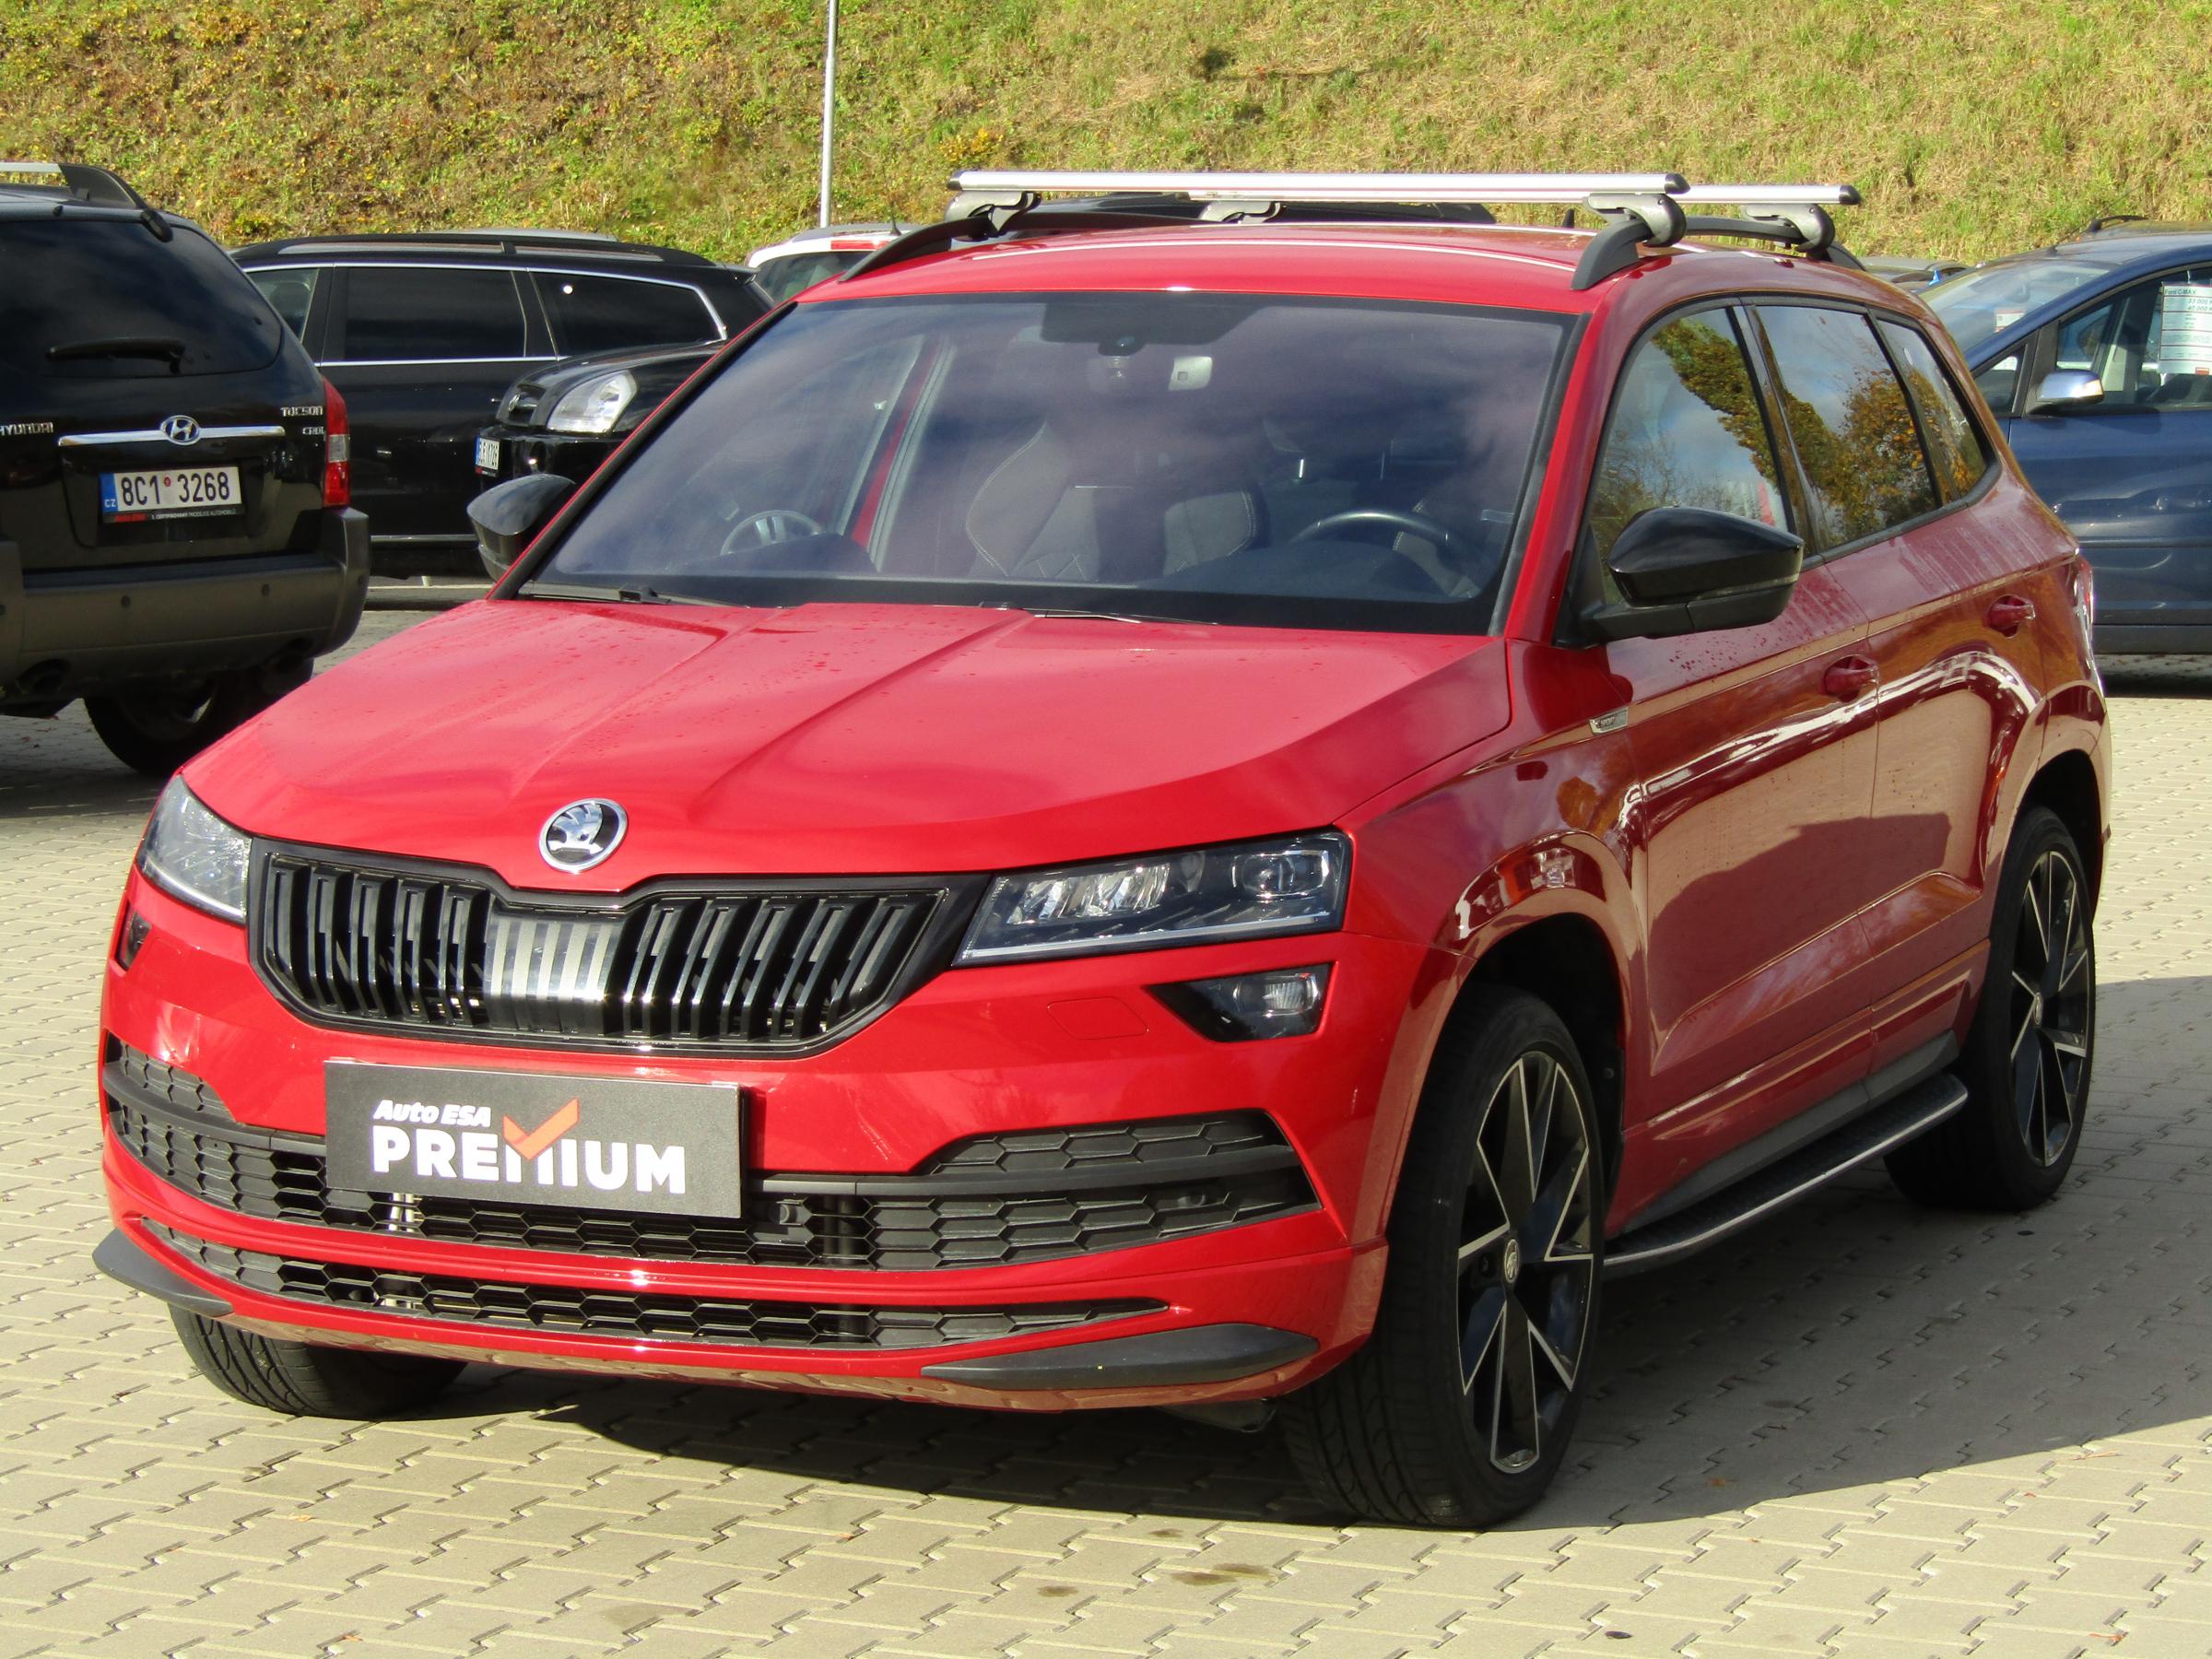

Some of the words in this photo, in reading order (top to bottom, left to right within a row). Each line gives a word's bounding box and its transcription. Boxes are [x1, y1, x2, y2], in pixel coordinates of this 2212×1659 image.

[280, 406, 324, 417] TUCSON
[121, 475, 161, 507] 8C1
[177, 471, 230, 503] 3268
[103, 498, 117, 508] CZ
[372, 1100, 440, 1124] Auto
[440, 1104, 491, 1127] ESA
[372, 1124, 686, 1194] PREMIUM
